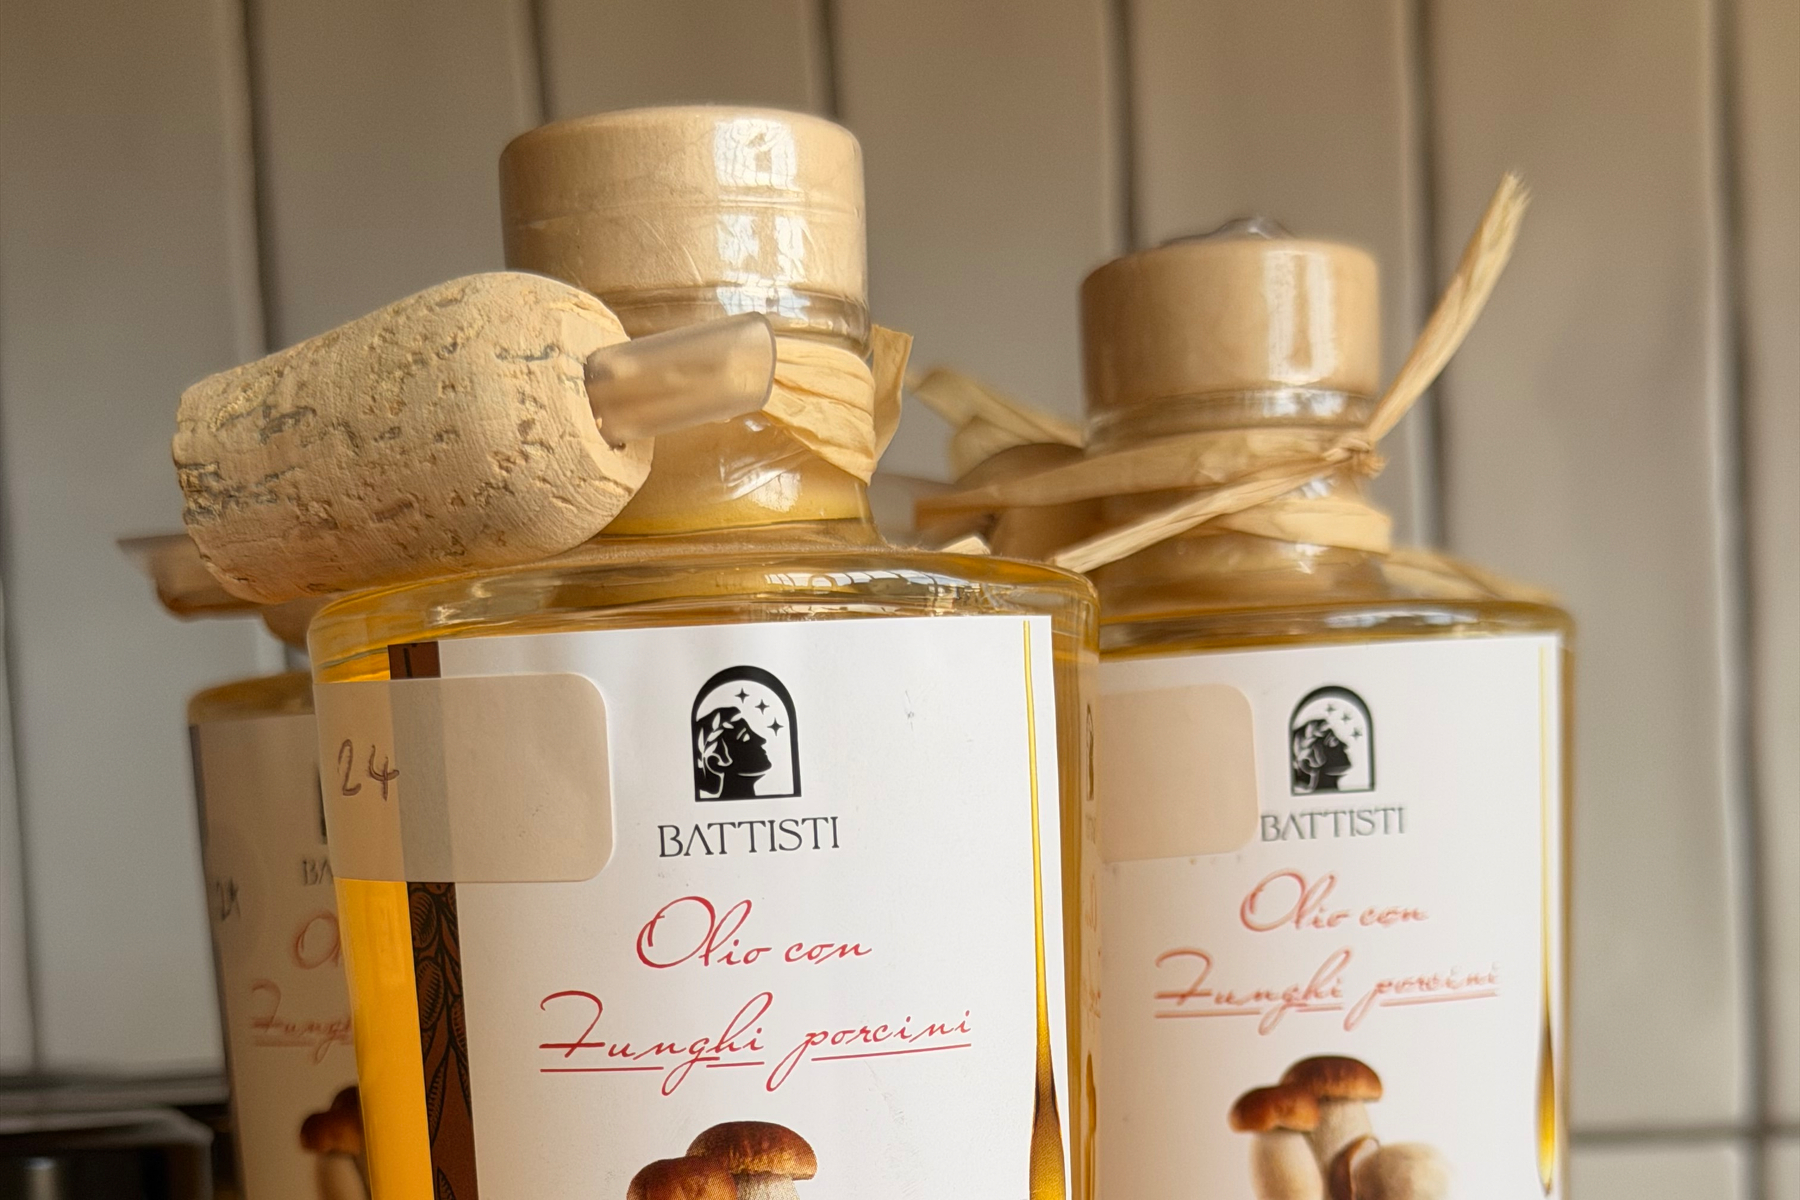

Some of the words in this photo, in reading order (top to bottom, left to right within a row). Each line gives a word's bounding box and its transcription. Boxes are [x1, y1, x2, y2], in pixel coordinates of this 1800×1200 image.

[336, 737, 400, 802] 24
[657, 815, 841, 858] BATTISTI
[1260, 805, 1406, 843] BATTISTI
[636, 895, 774, 969] Olio
[784, 942, 873, 964] con
[1240, 868, 1351, 933] Olio
[1358, 906, 1429, 928] con
[250, 979, 354, 1066] Fung
[1154, 946, 1352, 1036] Funghi
[1343, 962, 1501, 1033] porcini
[539, 990, 774, 1096] Funghi
[765, 1010, 973, 1092] porcini
